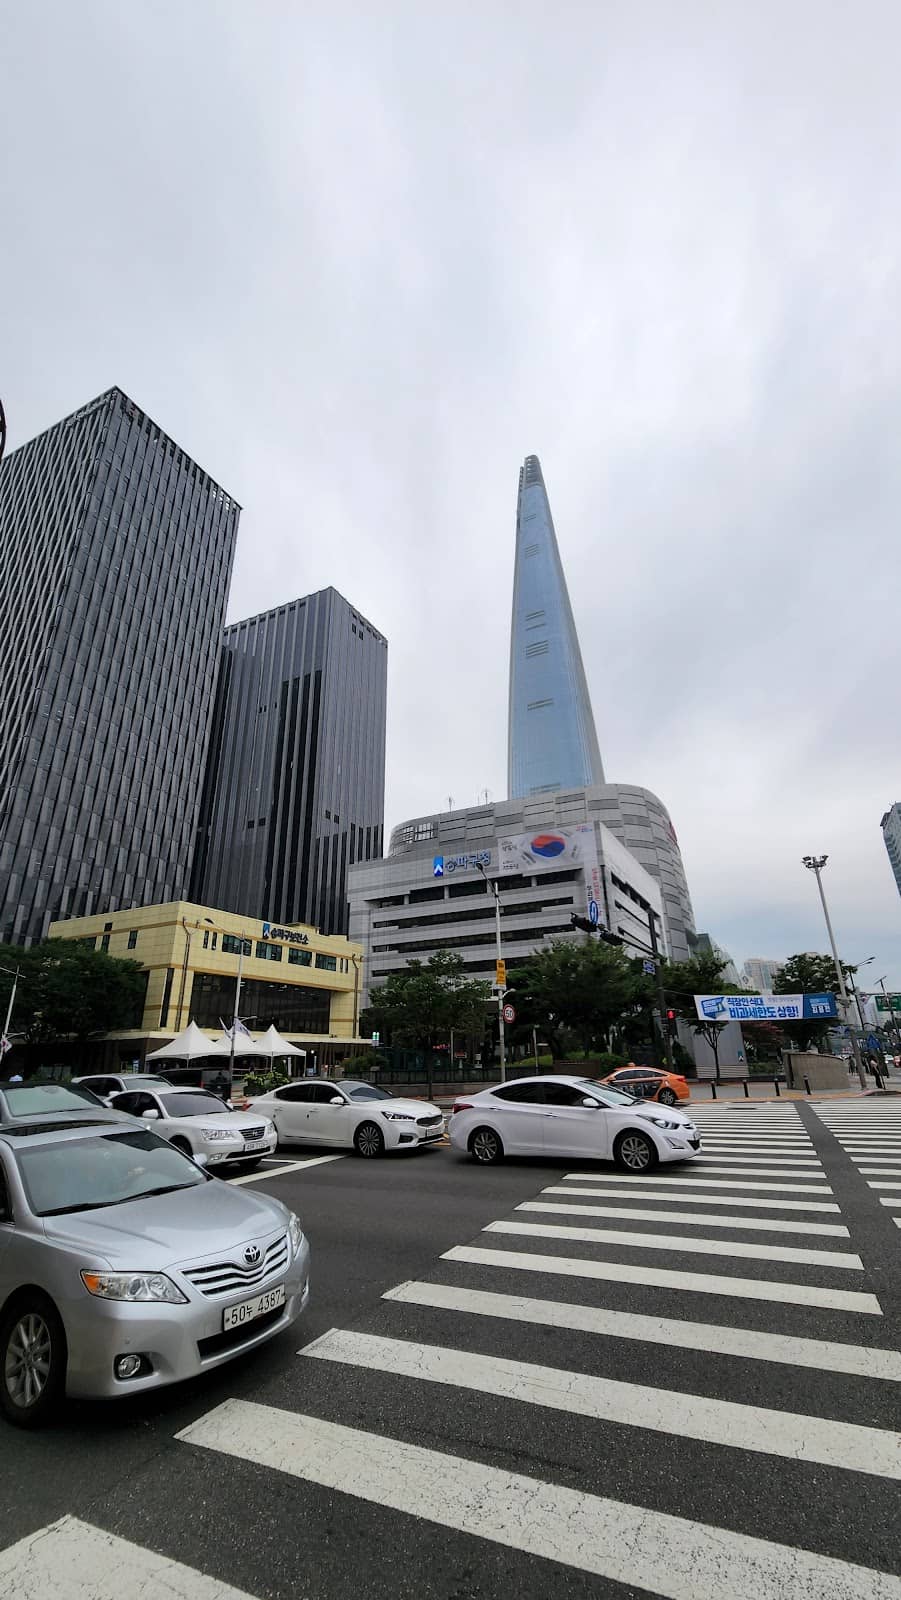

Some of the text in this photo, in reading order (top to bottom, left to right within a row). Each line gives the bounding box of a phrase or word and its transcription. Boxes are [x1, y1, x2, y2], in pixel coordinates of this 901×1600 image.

[445, 849, 491, 872] 송파구청
[271, 928, 309, 944] 송파구보건소
[726, 997, 749, 1006] 직장인
[729, 1006, 777, 1019] 비과세한도
[777, 1005, 800, 1018] 상향!
[231, 1289, 281, 1325] 50누 4387
